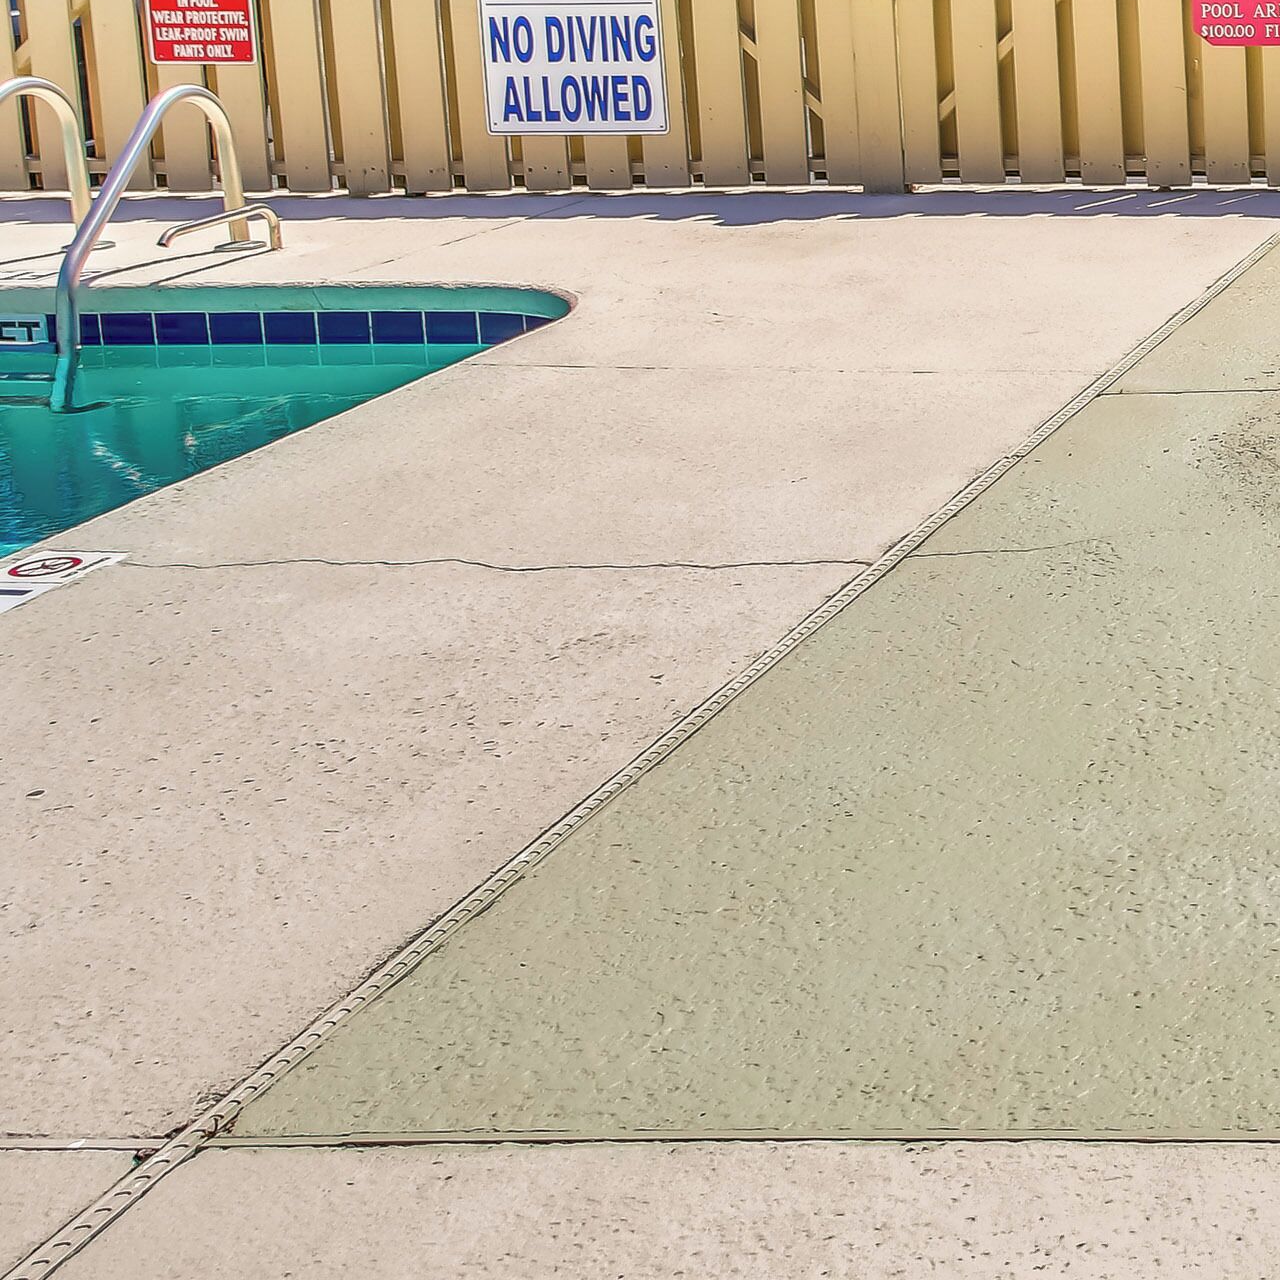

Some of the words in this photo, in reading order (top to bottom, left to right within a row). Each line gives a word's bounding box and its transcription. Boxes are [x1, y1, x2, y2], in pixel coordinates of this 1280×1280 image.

[1201, 3, 1244, 18] POOL
[152, 11, 184, 24] WEAR
[186, 11, 248, 26] PROTECTIVE,
[155, 28, 217, 41] LEAK-PROOF
[219, 28, 249, 42] SWIM
[488, 15, 534, 63] NO
[544, 14, 657, 63] DIVING
[1201, 24, 1255, 38] $100.00
[173, 44, 205, 57] PANTS
[206, 44, 234, 58] ONLY.
[503, 75, 652, 122] ALLOWED
